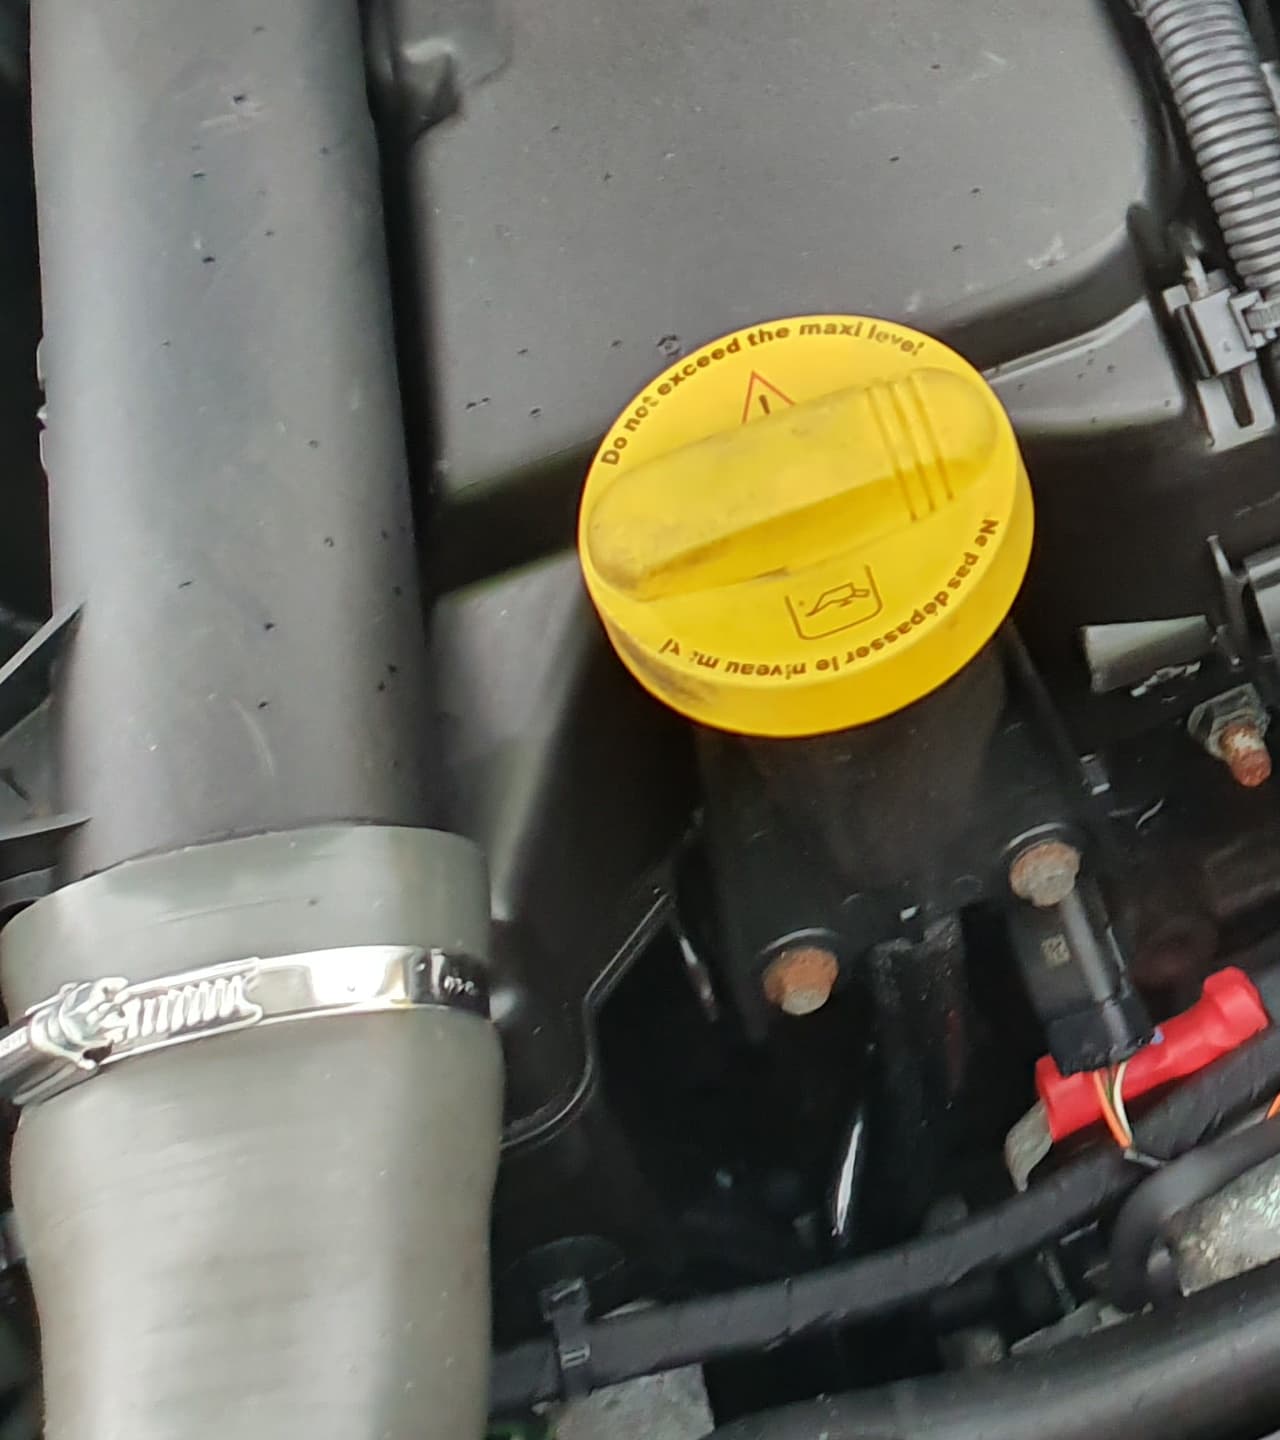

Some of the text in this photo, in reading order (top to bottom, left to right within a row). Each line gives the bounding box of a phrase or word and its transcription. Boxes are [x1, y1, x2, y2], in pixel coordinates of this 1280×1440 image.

[601, 435, 628, 466] Do
[624, 395, 661, 434] not
[657, 338, 741, 398] exceed
[747, 324, 790, 348] the
[799, 321, 864, 338] maxi
[974, 517, 999, 547] Ne
[947, 551, 980, 594] pas
[725, 660, 807, 680] niveau
[815, 654, 841, 673] le
